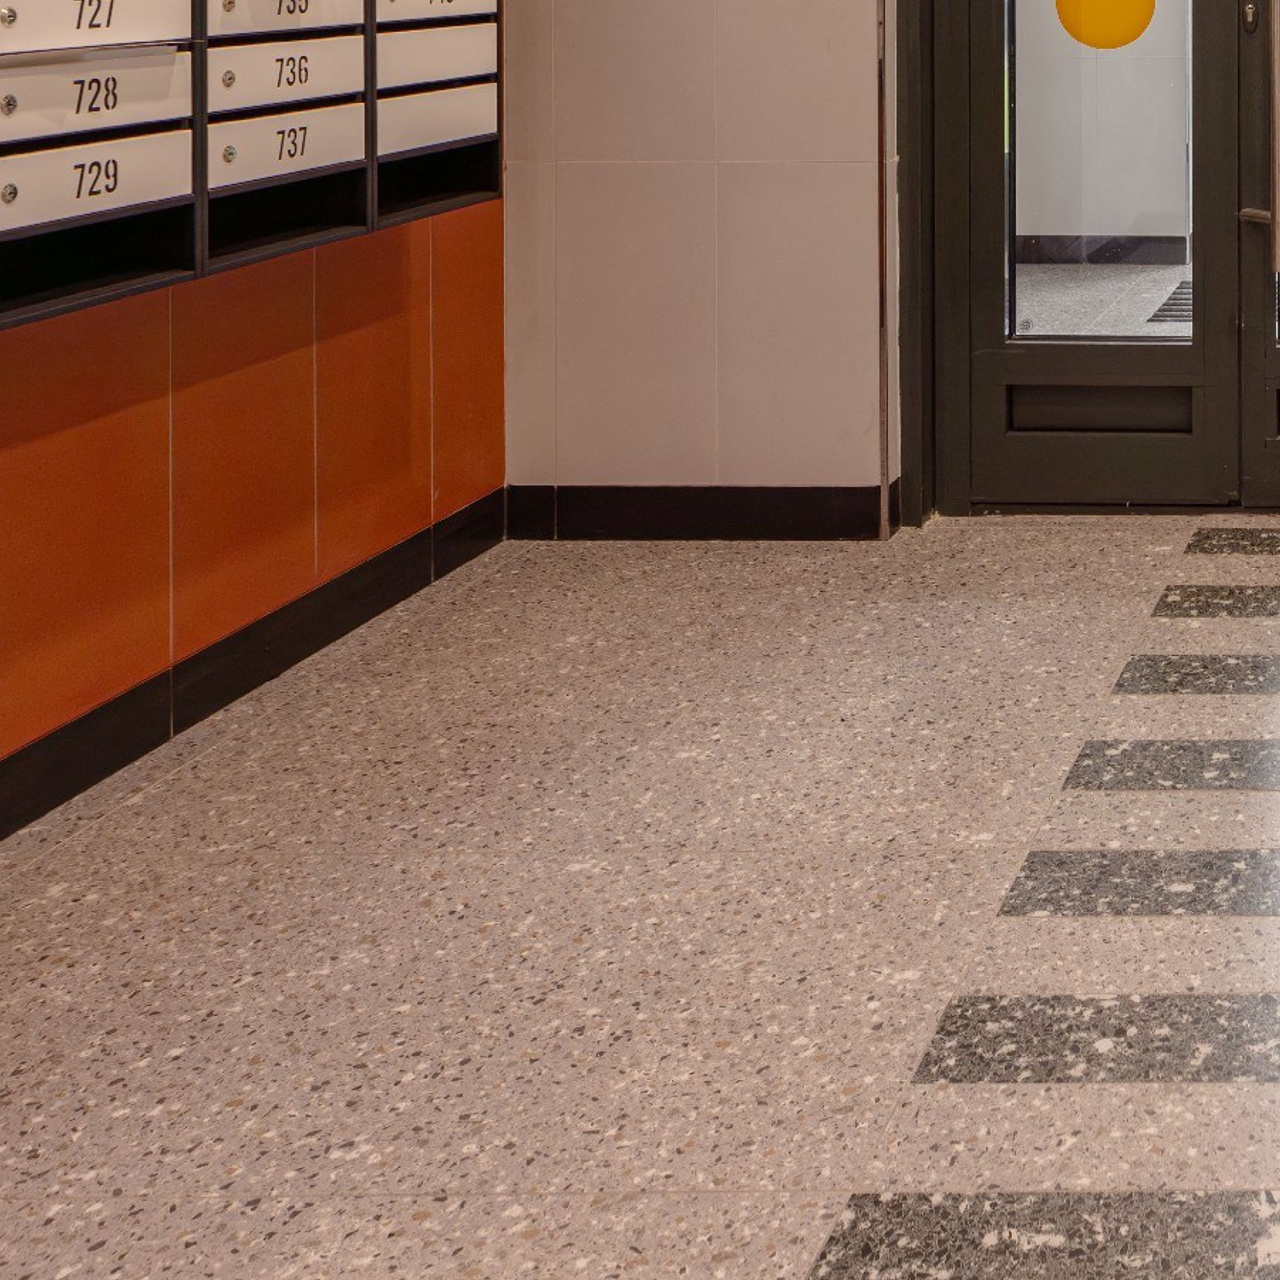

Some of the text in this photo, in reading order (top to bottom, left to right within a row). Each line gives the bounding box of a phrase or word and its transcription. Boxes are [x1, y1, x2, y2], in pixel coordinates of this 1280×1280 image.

[276, 56, 308, 87] 736
[73, 77, 117, 114] 728
[277, 127, 307, 160] 737
[74, 160, 117, 198] 729
